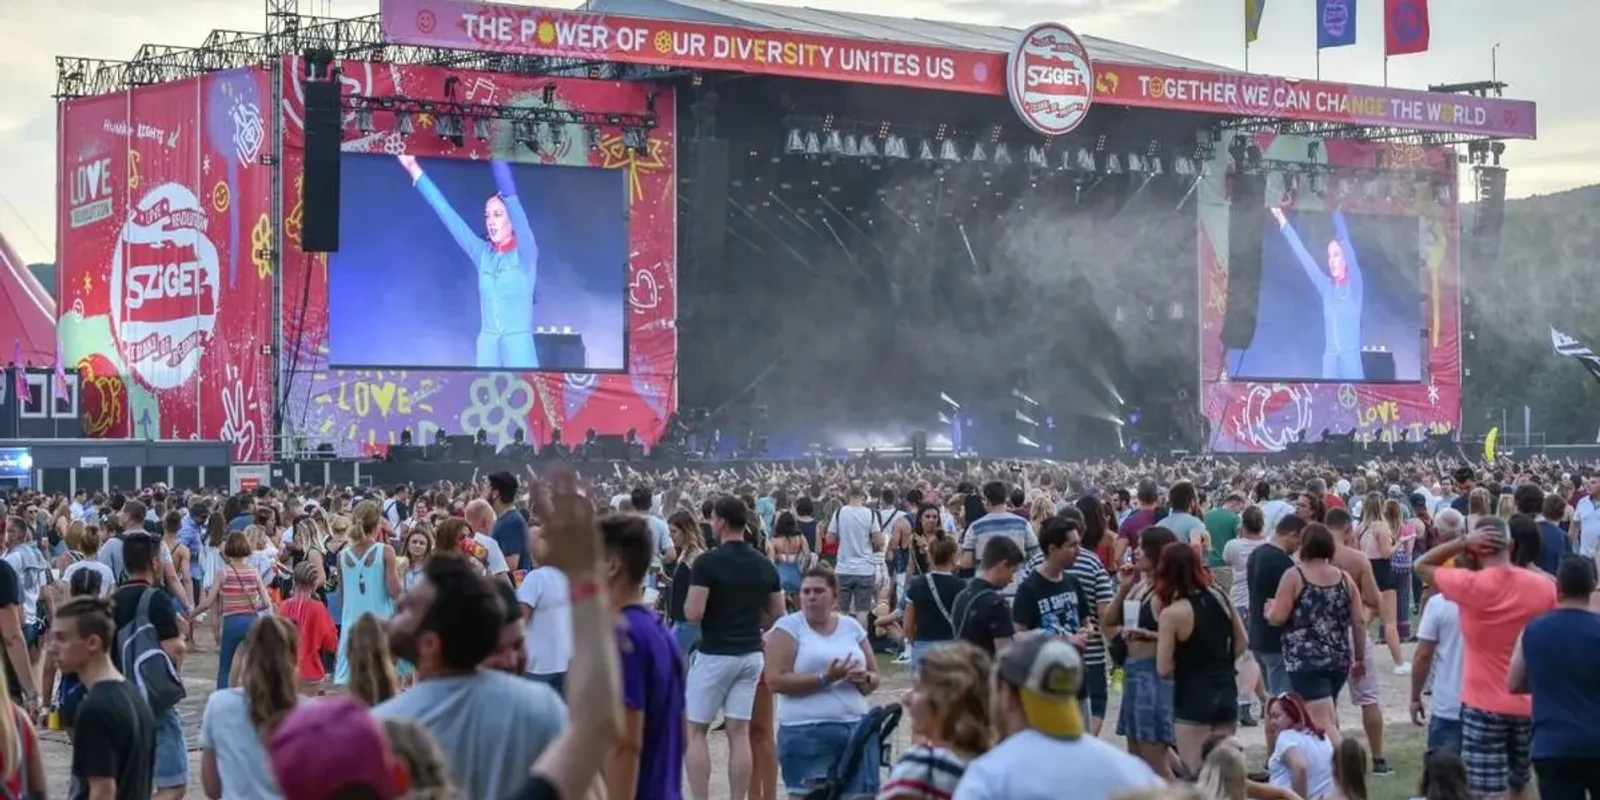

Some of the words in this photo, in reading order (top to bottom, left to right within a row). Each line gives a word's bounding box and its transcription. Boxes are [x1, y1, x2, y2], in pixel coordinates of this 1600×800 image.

[462, 13, 513, 40] THE
[616, 28, 648, 51] OF
[713, 35, 834, 68] DIVERSITY
[926, 56, 954, 80] US
[1242, 85, 1269, 106] WE
[1274, 88, 1309, 110] CAN
[1316, 91, 1386, 116] CHANGE
[1390, 98, 1423, 120] THE
[71, 158, 112, 205] LOVE
[338, 382, 412, 418] LOVE
[1357, 401, 1400, 427] LOVE
